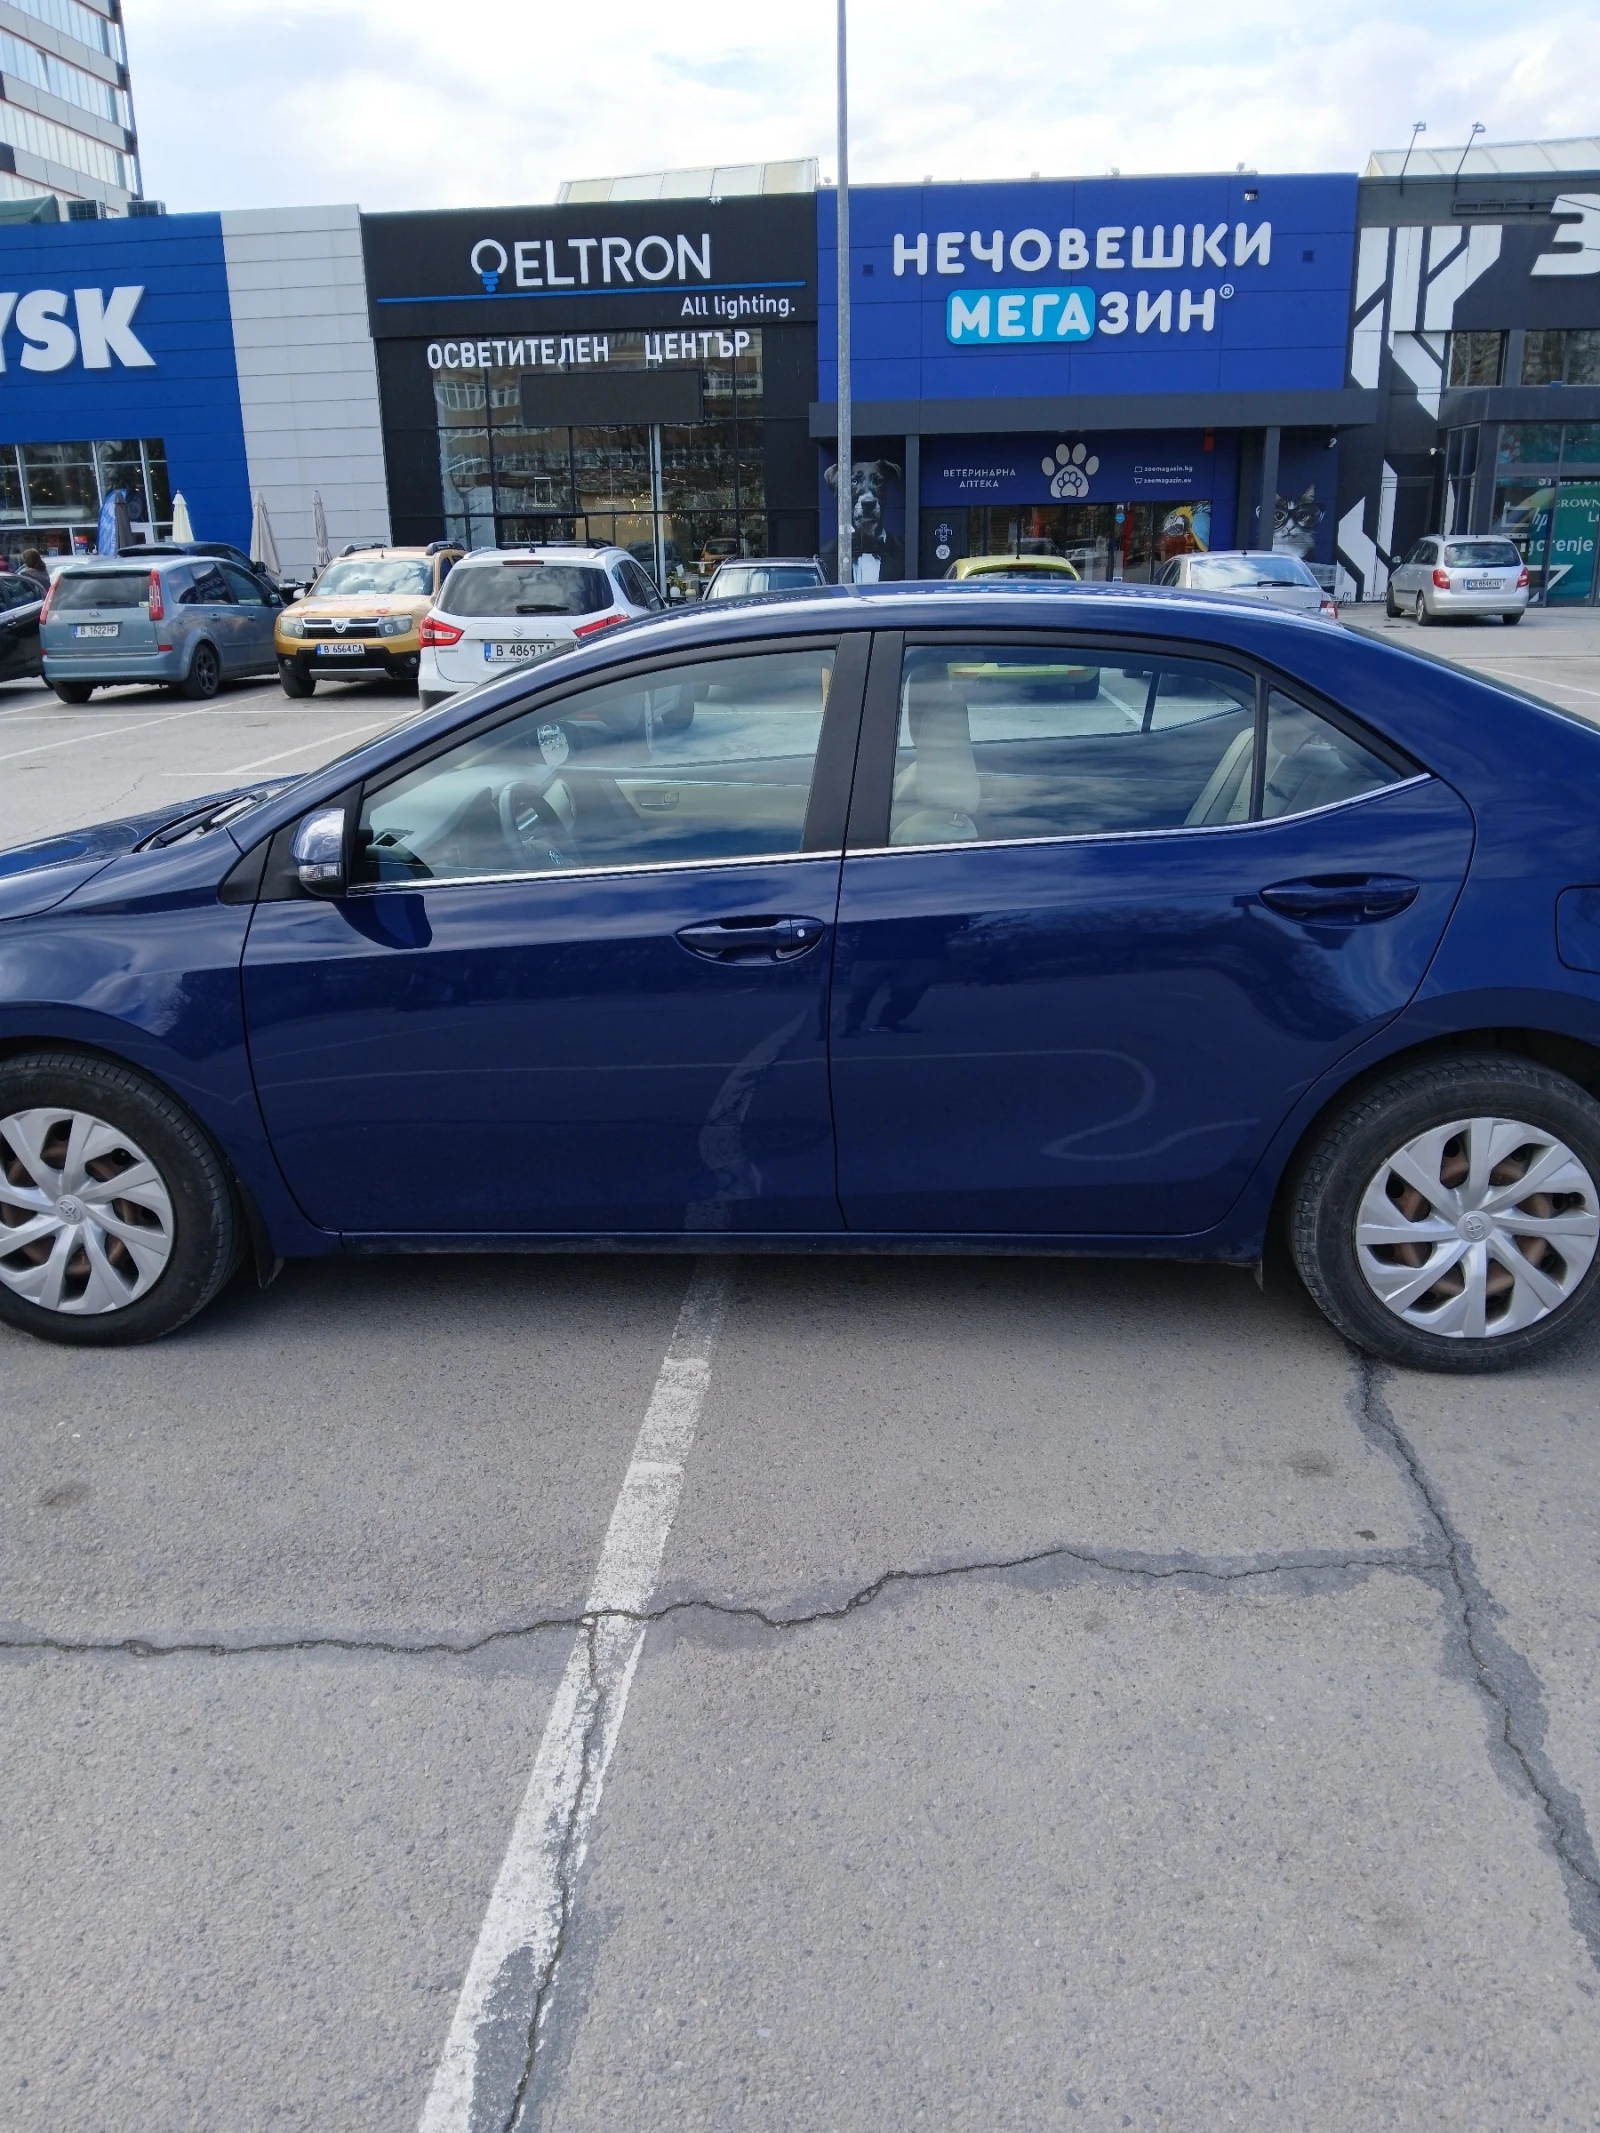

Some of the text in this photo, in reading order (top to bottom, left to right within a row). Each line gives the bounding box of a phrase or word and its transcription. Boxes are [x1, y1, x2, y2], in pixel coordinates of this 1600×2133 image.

[893, 222, 1272, 276] НЕЧОВЕШКИ
[680, 294, 796, 320] All lighting.
[426, 331, 751, 370] ОСВЕТИТЕЛЕН ЦЕНТЪР
[943, 468, 1016, 478] ВЕТЕРИНАРНА
[959, 479, 999, 489] АПТЕКА
[1531, 507, 1548, 532] hp
[496, 646, 503, 656] B
[509, 645, 536, 656] 4869
